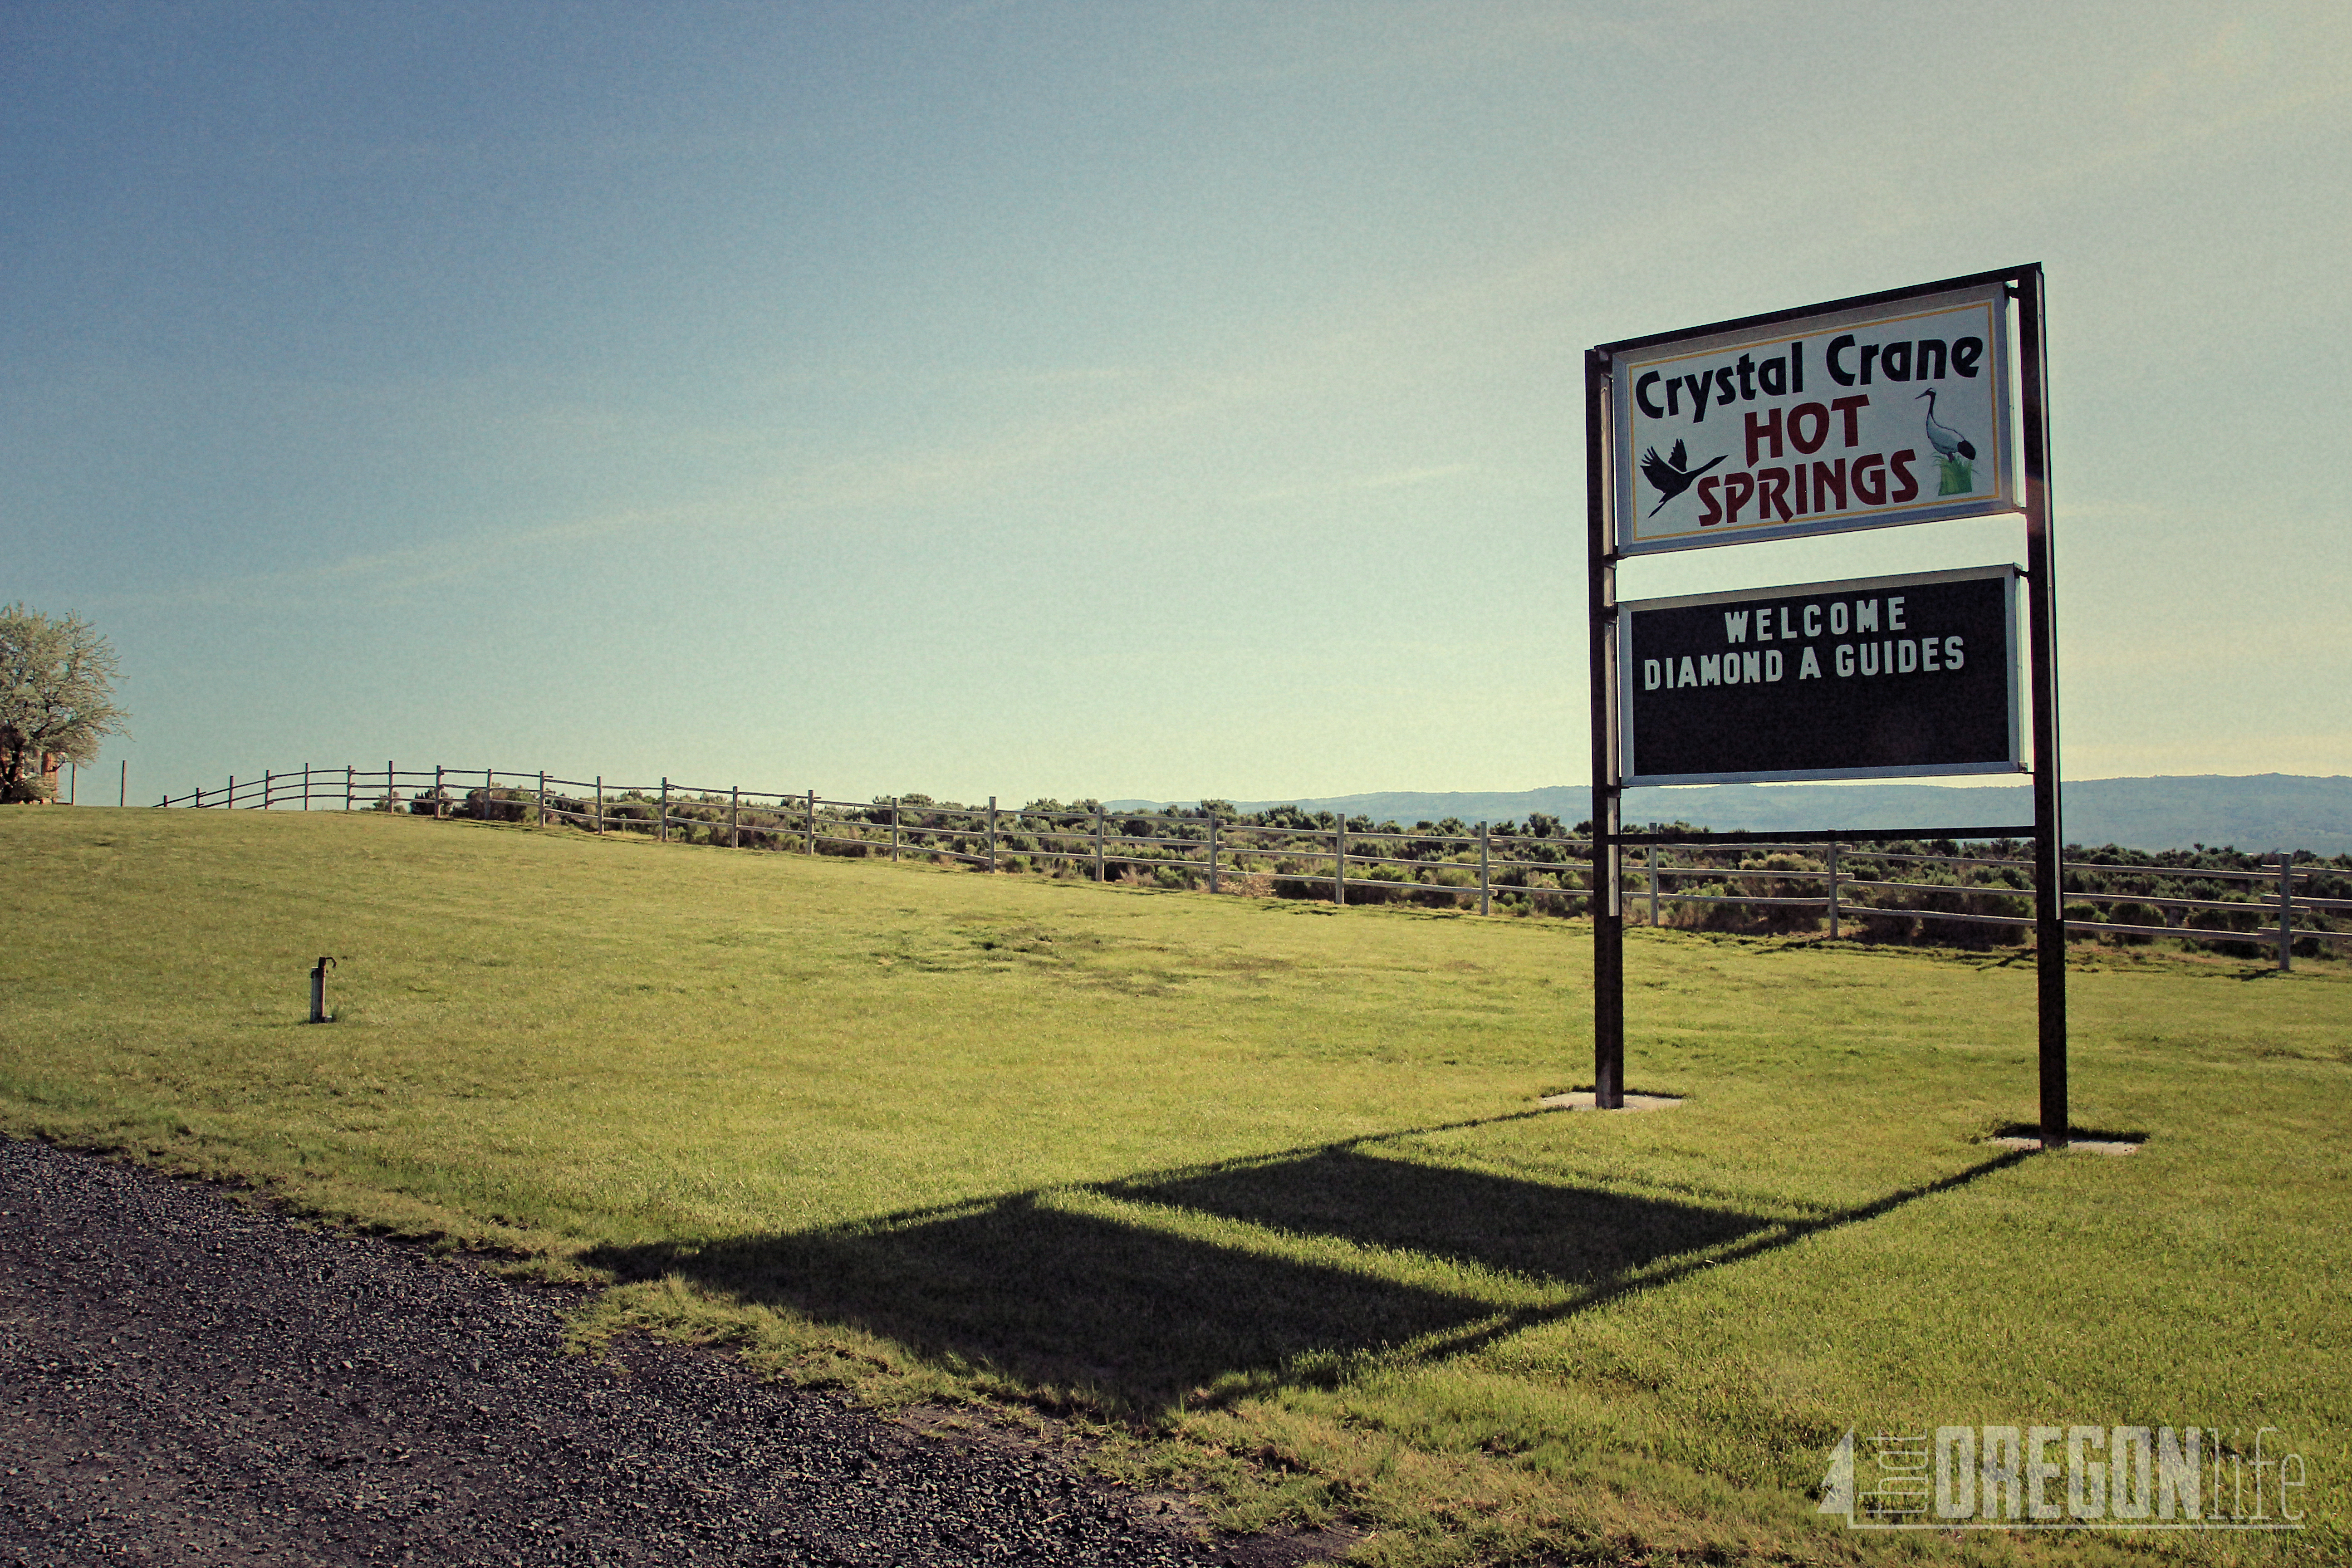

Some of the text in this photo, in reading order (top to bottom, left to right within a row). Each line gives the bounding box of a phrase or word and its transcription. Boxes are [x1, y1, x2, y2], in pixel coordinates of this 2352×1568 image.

[1636, 334, 1983, 423] Crystal Crane
[1744, 394, 1870, 468] HOT
[1698, 449, 1919, 527] SPRINGS
[1725, 597, 1906, 643] WELCOME
[1645, 636, 1964, 690] DIAMOND A GUIDES
